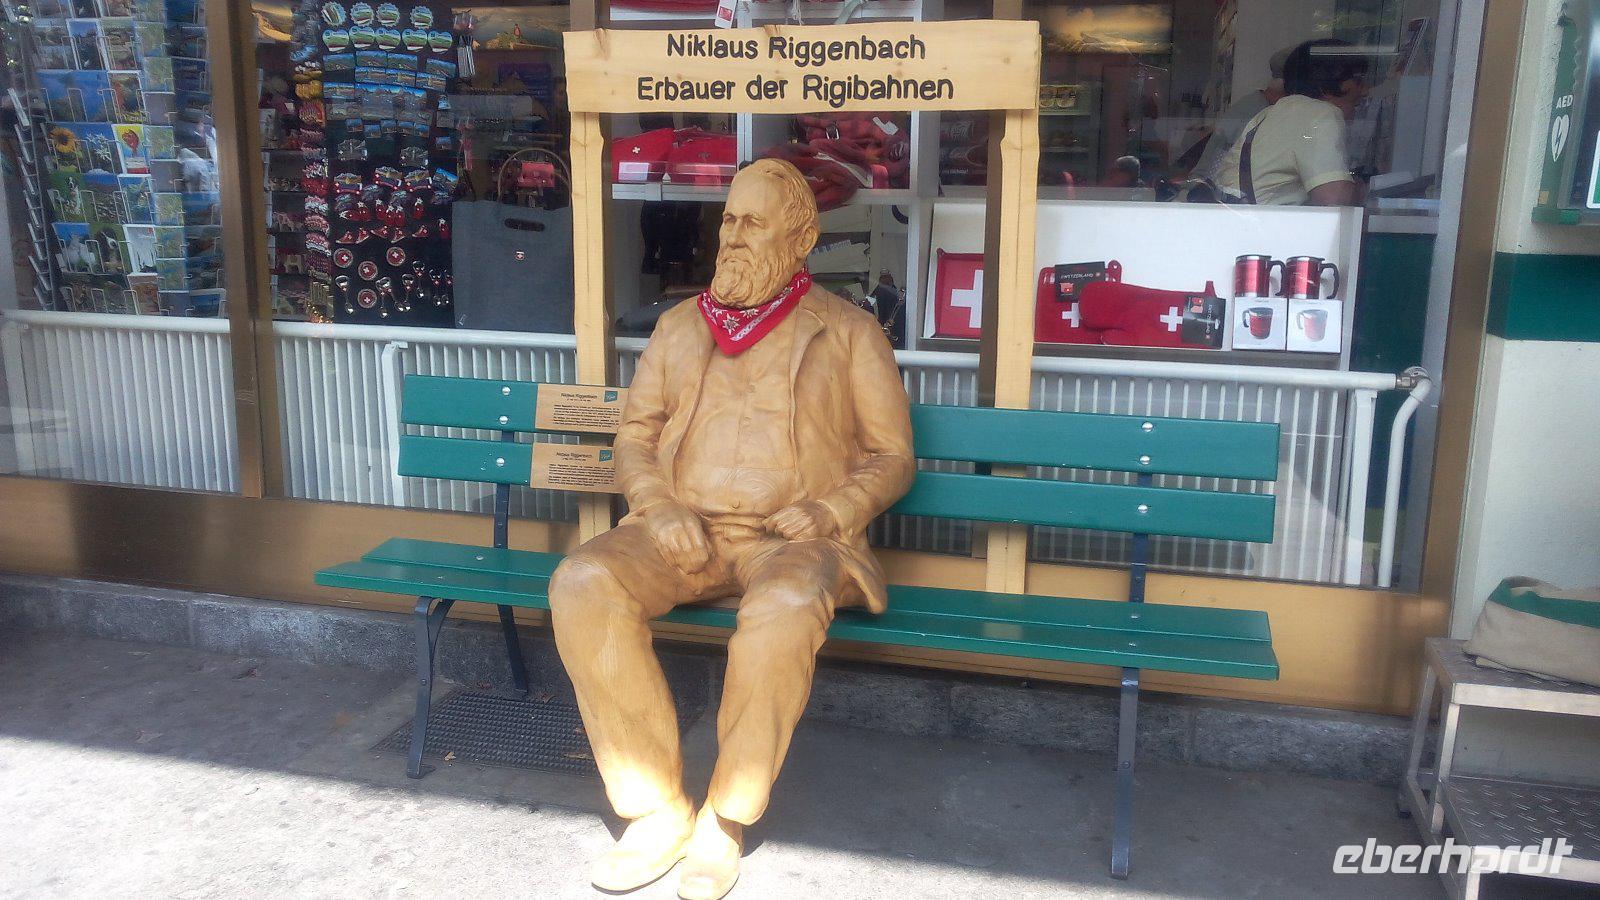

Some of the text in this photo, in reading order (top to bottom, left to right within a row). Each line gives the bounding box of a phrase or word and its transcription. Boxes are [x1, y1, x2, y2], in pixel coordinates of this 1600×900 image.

[667, 33, 926, 67] Niklaus Riggenbach
[637, 74, 954, 109] Erbauer der Rigibahnen
[1555, 94, 1574, 109] AED
